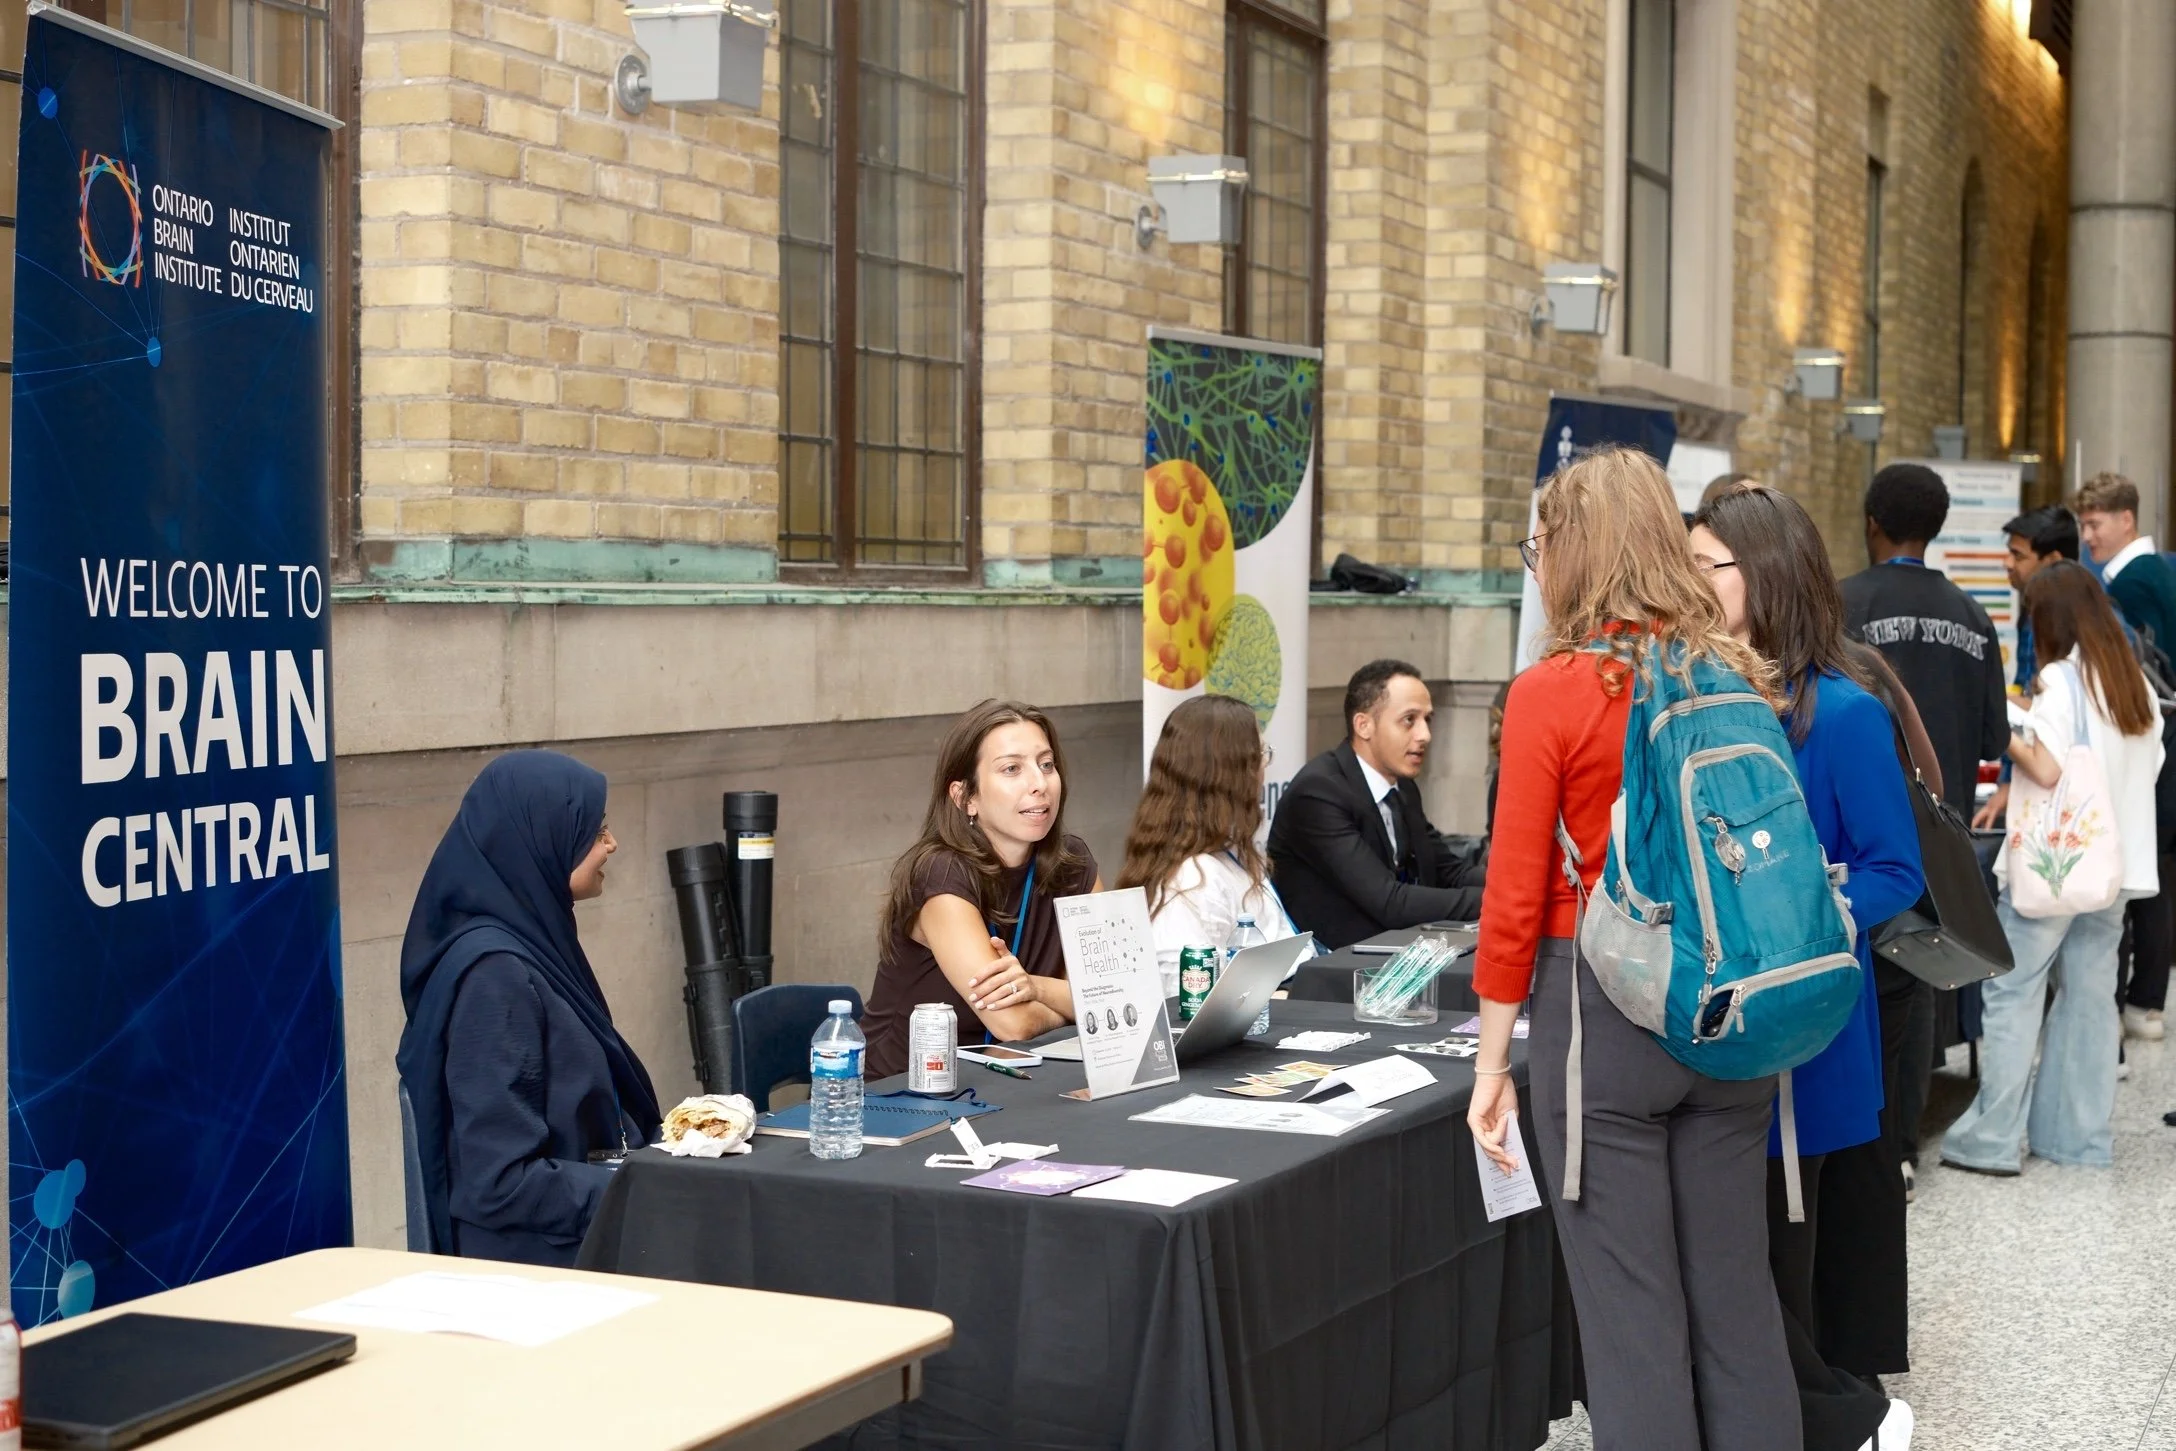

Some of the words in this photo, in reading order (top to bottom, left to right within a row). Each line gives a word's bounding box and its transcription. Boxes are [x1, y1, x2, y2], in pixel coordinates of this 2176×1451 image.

[152, 183, 214, 227] ONTARIO
[154, 217, 194, 255] BRAIN
[229, 207, 291, 247] INSTITUT
[154, 251, 223, 295] INSTITUTE
[229, 239, 300, 280] ONTARIEN
[231, 271, 252, 300] DU
[254, 279, 314, 314] CERVEAU
[80, 557, 270, 619] WELCOME
[278, 564, 323, 619] TO
[1862, 616, 1917, 646] NEW
[1918, 617, 1989, 661] YORK
[81, 649, 328, 785] BRAIN
[81, 794, 330, 908] CENTRAL
[1080, 937, 1110, 956] Brain
[1083, 953, 1120, 975] Health
